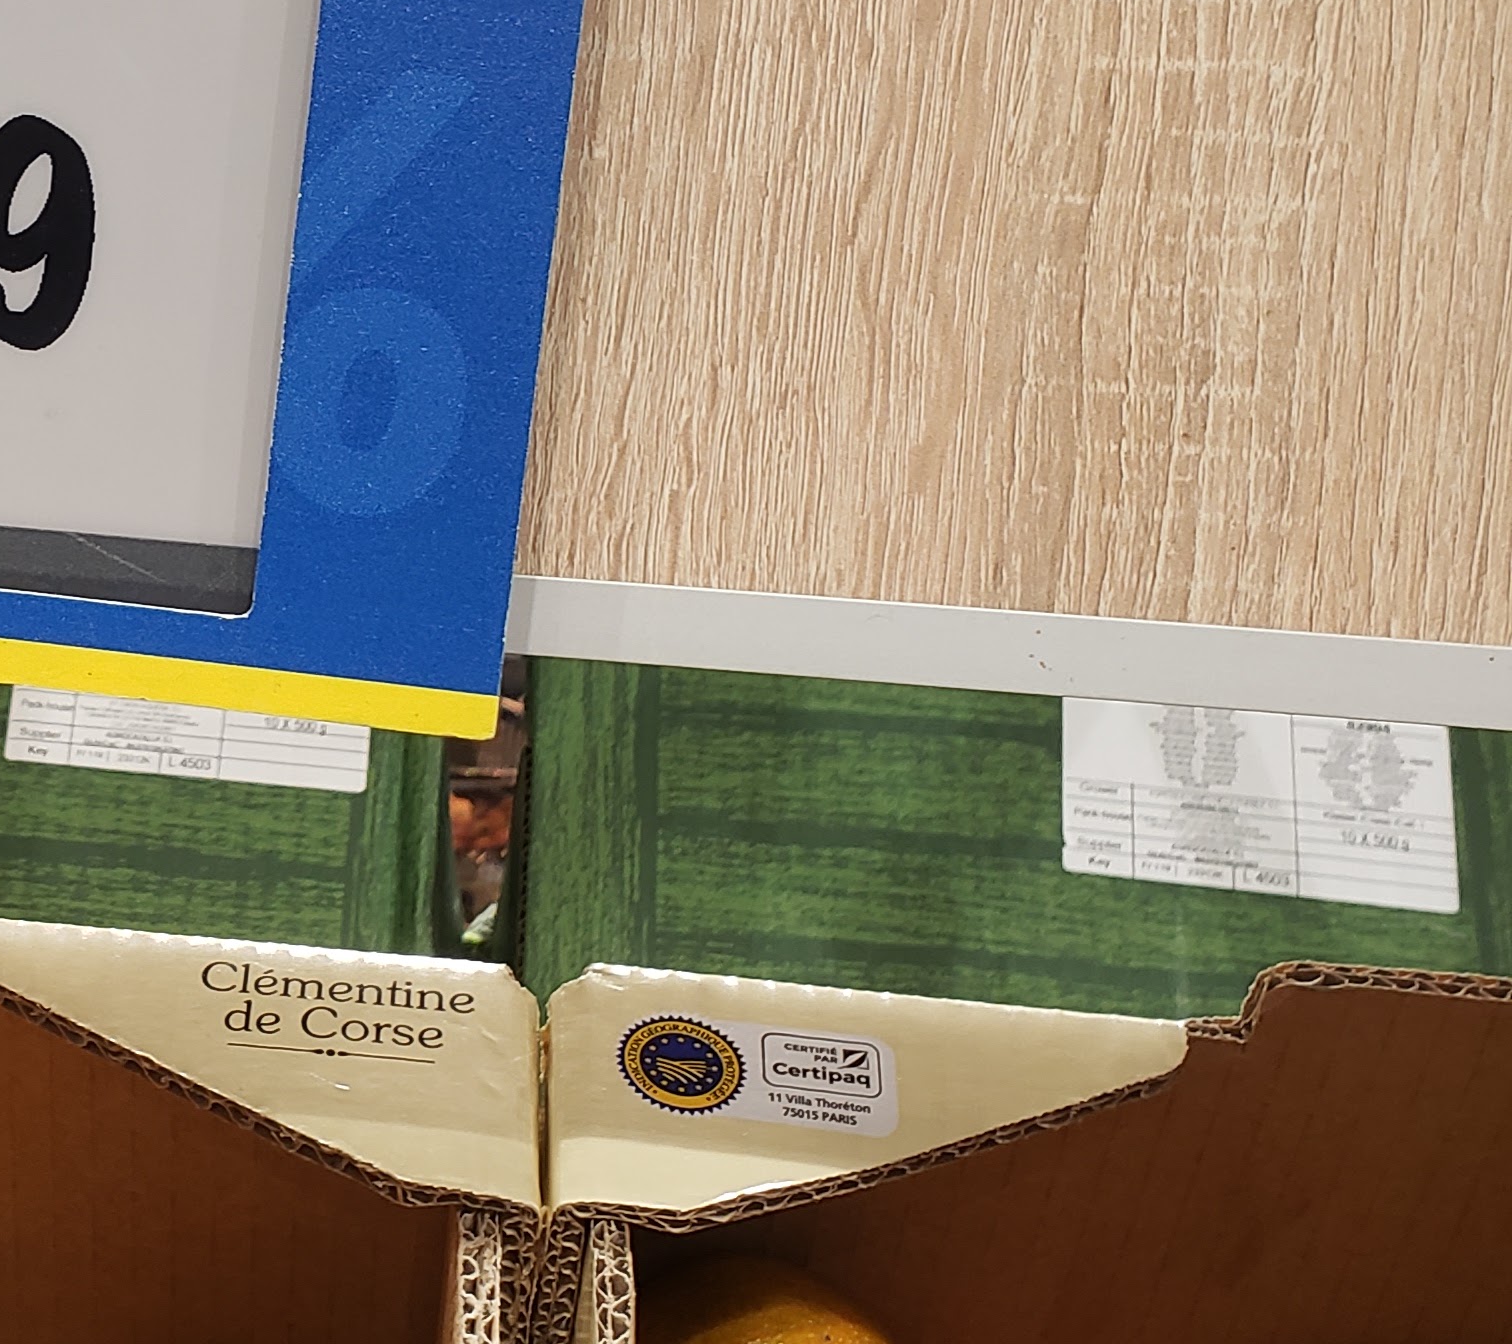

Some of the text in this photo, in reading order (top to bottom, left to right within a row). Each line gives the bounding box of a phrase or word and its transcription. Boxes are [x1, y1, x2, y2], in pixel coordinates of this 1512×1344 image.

[201, 961, 476, 1014] Clémentine
[223, 999, 444, 1049] de Corse
[783, 1042, 838, 1056] CERTIFIÉ
[813, 1053, 838, 1064] PAR
[627, 1035, 655, 1092] INDICATION
[771, 1061, 871, 1089] Certipaq
[768, 1091, 872, 1115] 11 Villa Thoréton
[781, 1106, 859, 1127] 75015 PARIS
